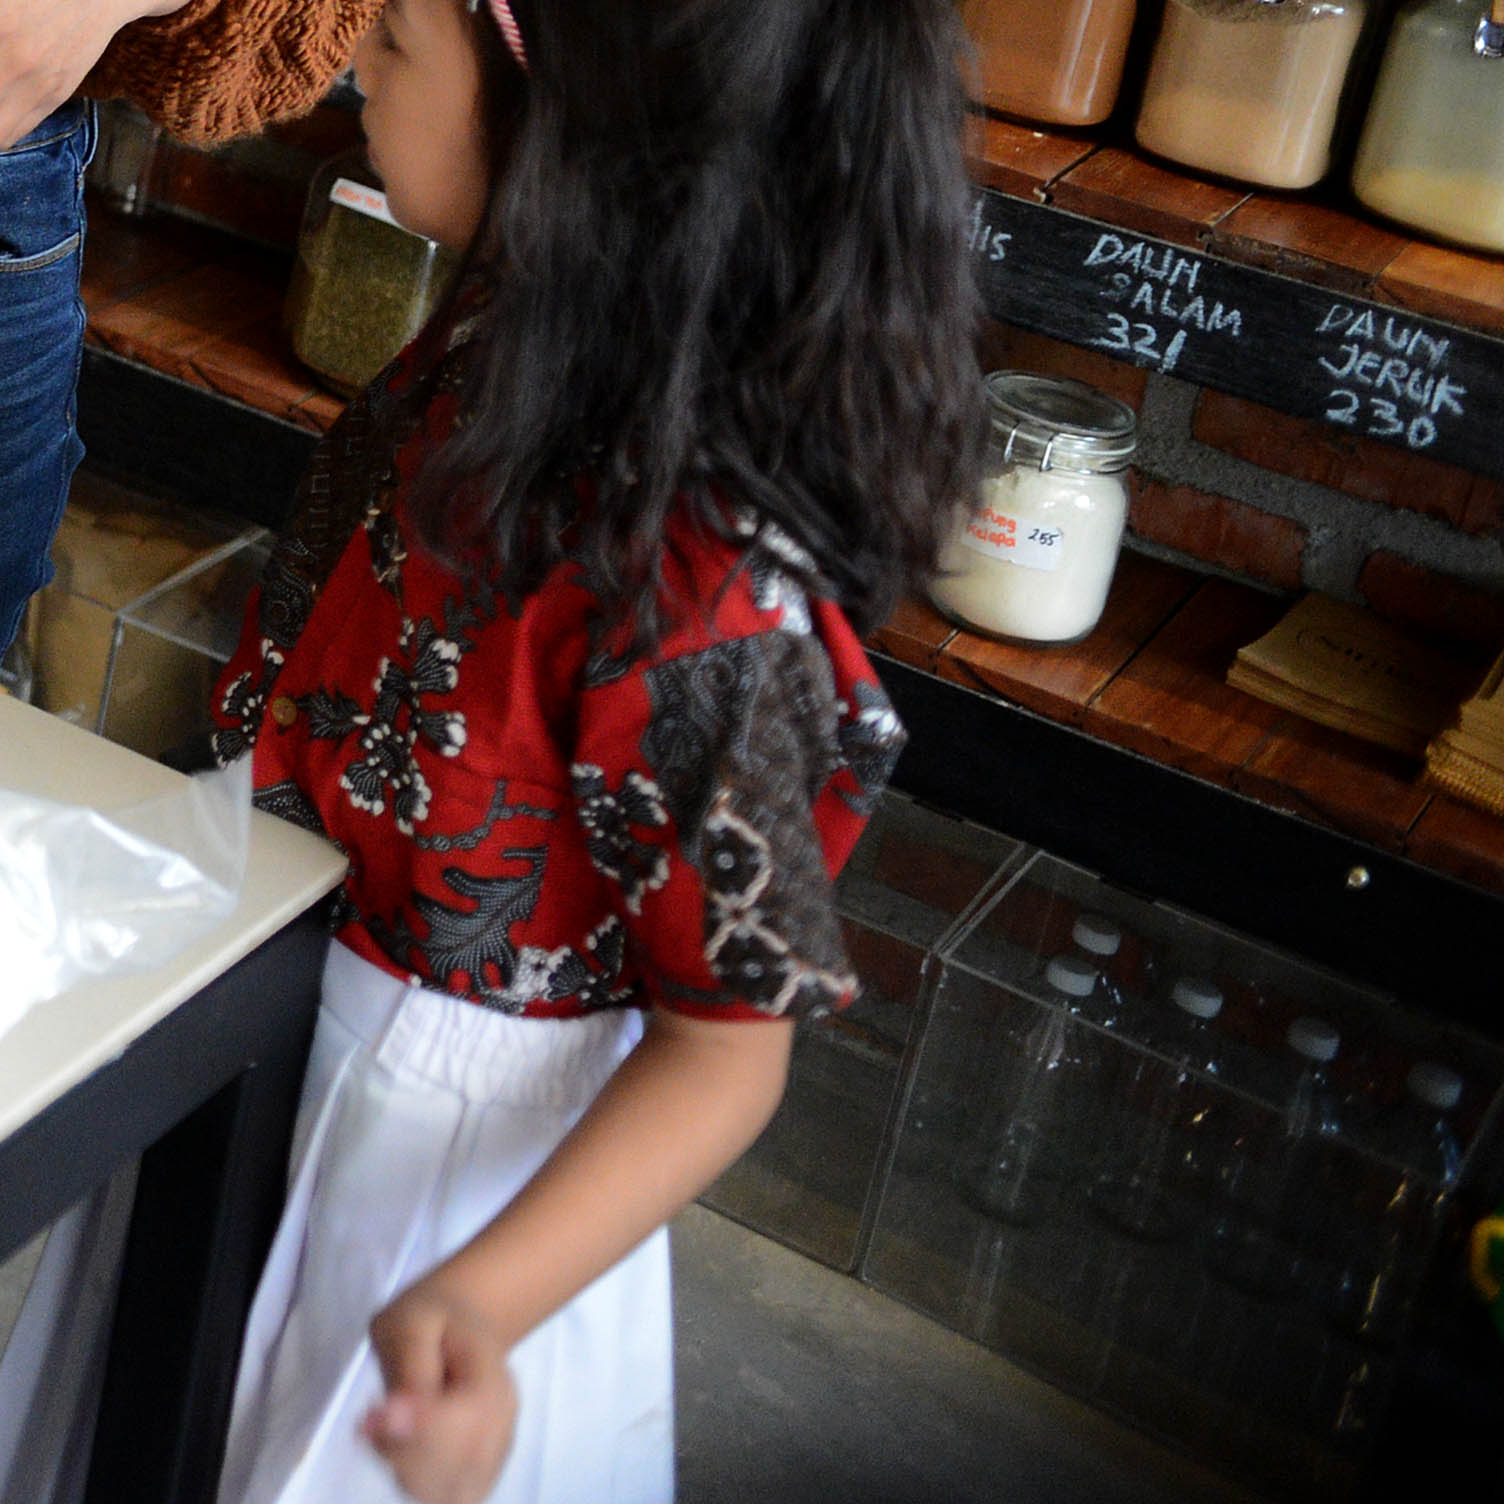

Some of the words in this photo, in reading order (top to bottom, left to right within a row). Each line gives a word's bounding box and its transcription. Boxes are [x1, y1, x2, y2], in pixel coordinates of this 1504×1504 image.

[1082, 232, 1201, 291] DAUN
[1099, 271, 1242, 337] SALAM
[1090, 312, 1189, 375] 321
[1318, 342, 1470, 416] JERUK
[1324, 389, 1439, 450] 230
